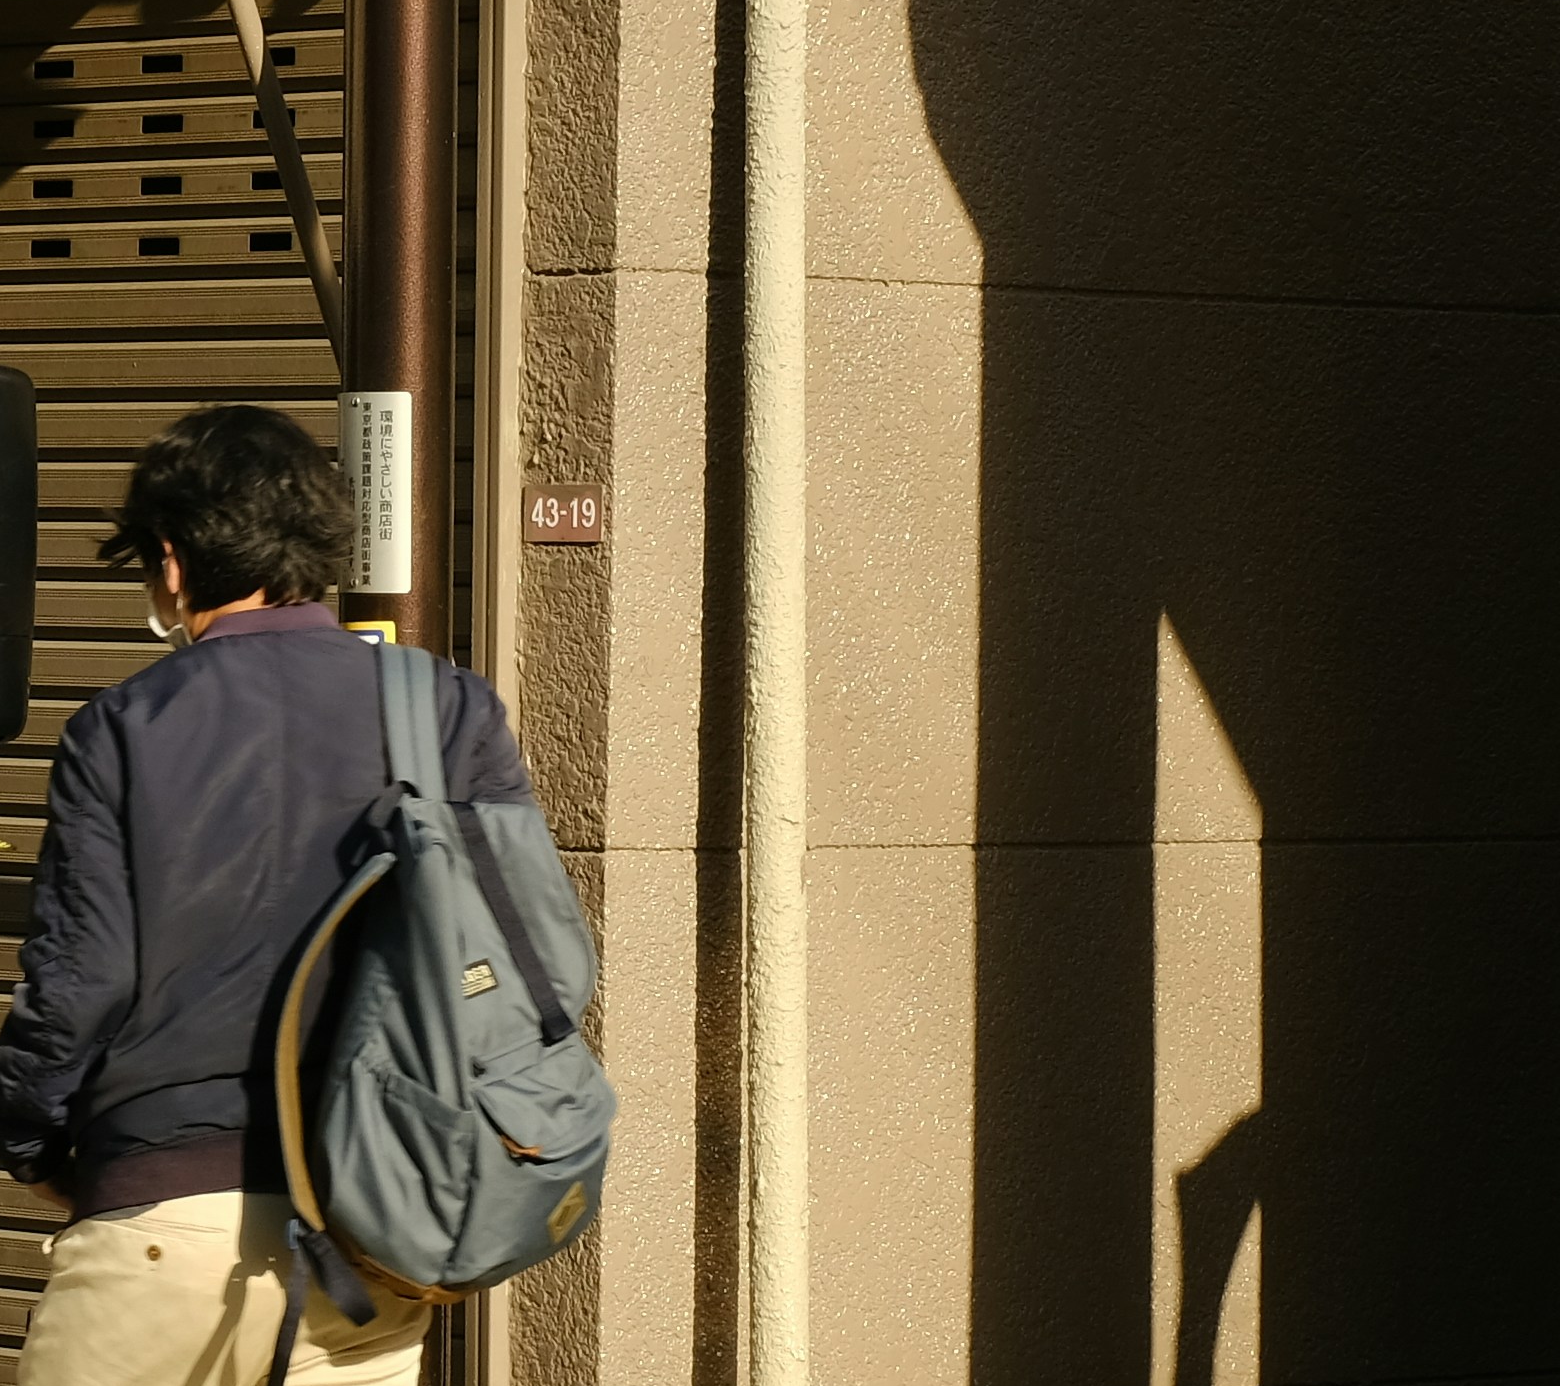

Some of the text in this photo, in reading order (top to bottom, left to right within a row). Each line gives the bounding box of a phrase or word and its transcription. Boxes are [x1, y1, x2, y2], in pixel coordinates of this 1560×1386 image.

[378, 409, 394, 541] 環境にやさしい商店街
[531, 497, 596, 530] 43-19
